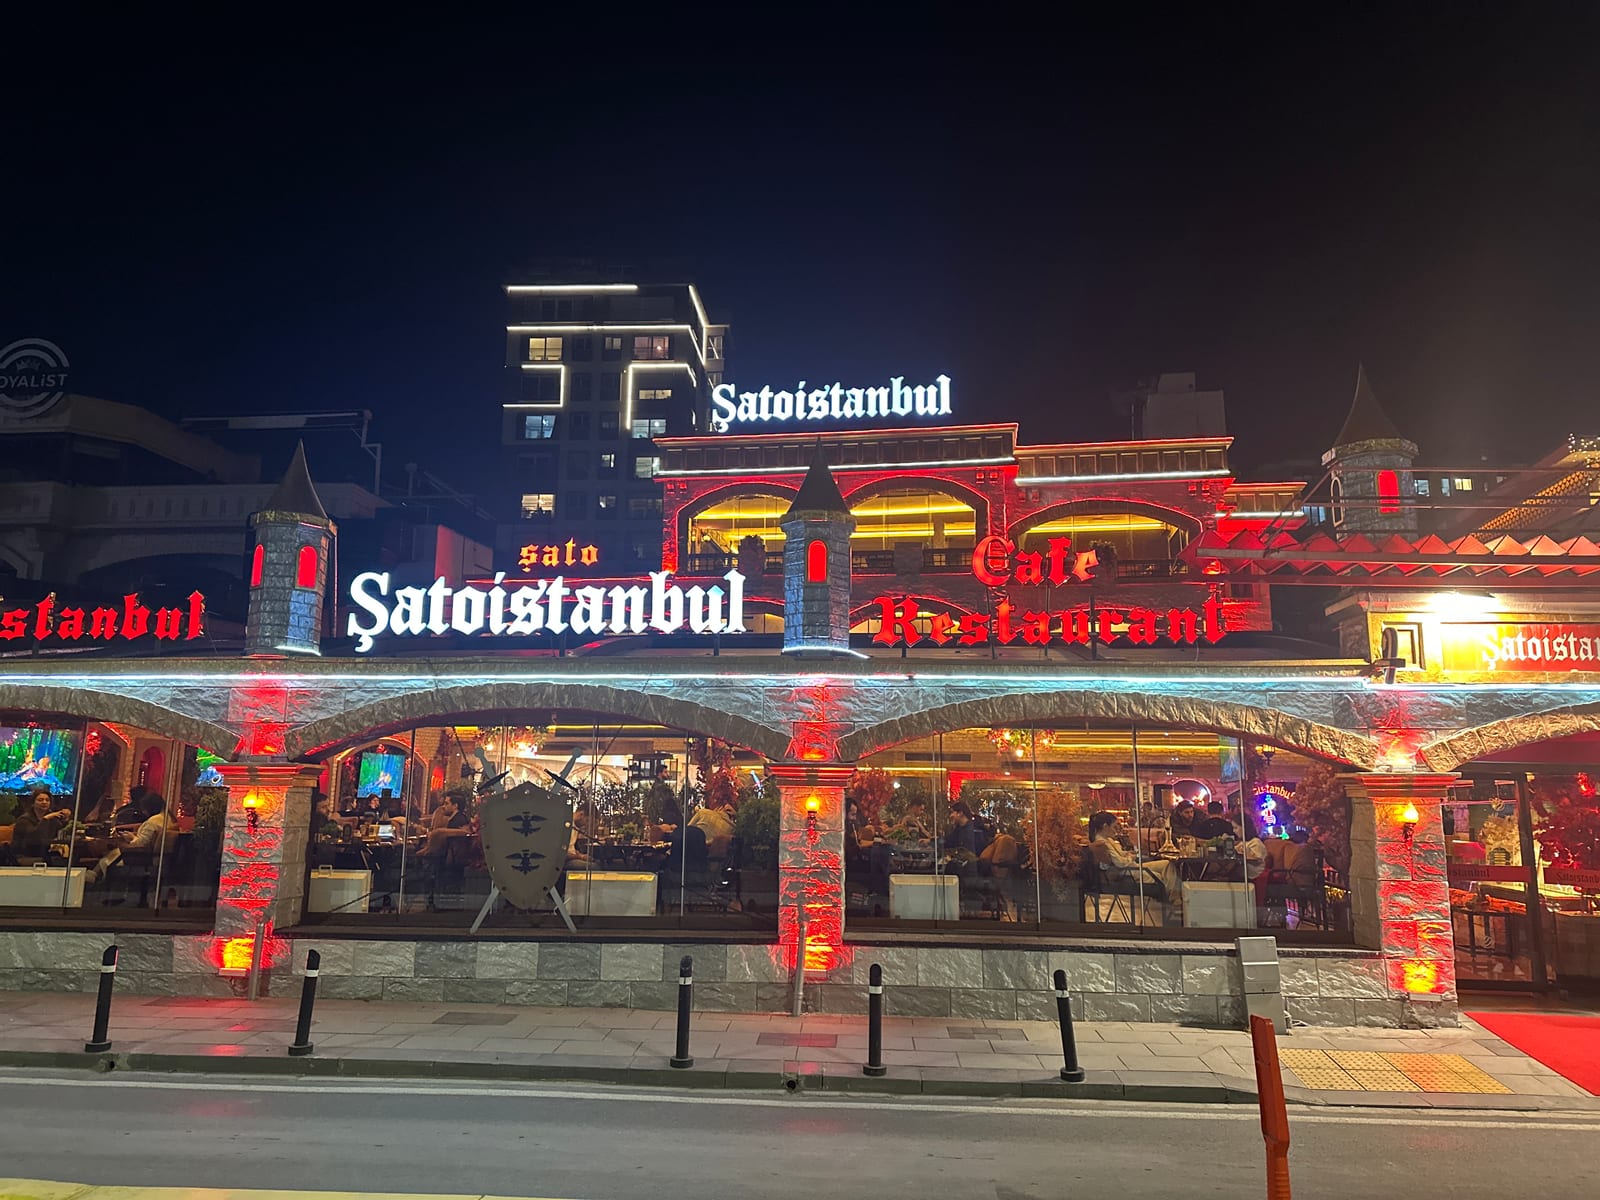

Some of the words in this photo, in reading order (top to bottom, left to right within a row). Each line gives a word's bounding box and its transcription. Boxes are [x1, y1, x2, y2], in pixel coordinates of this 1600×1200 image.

[711, 374, 953, 433] Şatoistanbul
[972, 536, 1099, 587] Cafe
[346, 568, 747, 653] Şatoistanbul
[872, 594, 1227, 648] Restaurant
